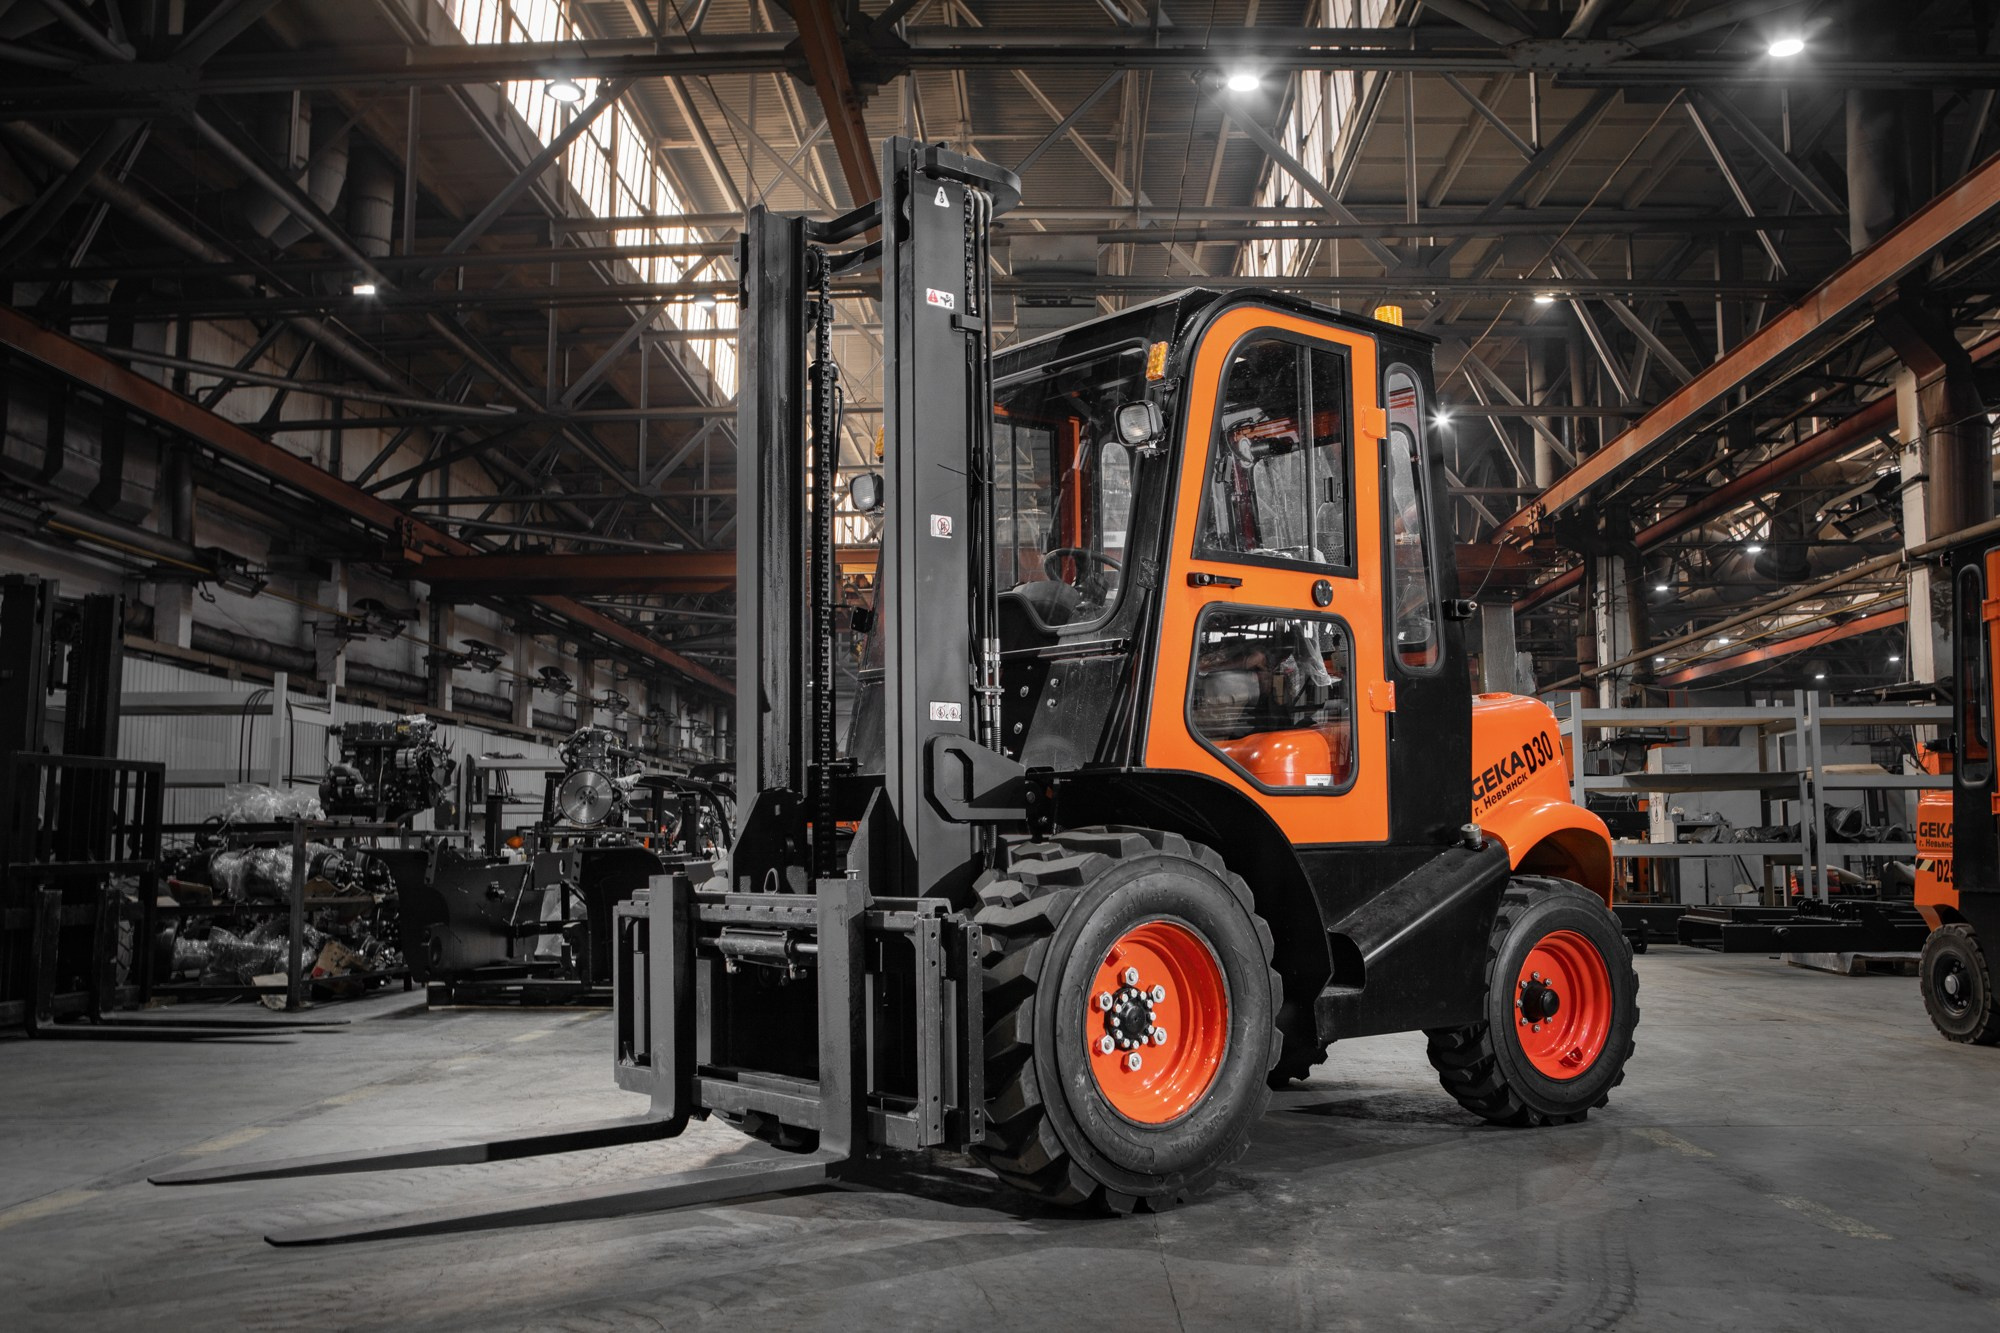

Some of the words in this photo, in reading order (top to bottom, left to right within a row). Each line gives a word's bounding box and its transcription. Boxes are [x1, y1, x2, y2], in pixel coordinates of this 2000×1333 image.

[1472, 751, 1525, 801] GEKA
[1522, 731, 1554, 774] D30
[1483, 772, 1528, 810] Невьянск
